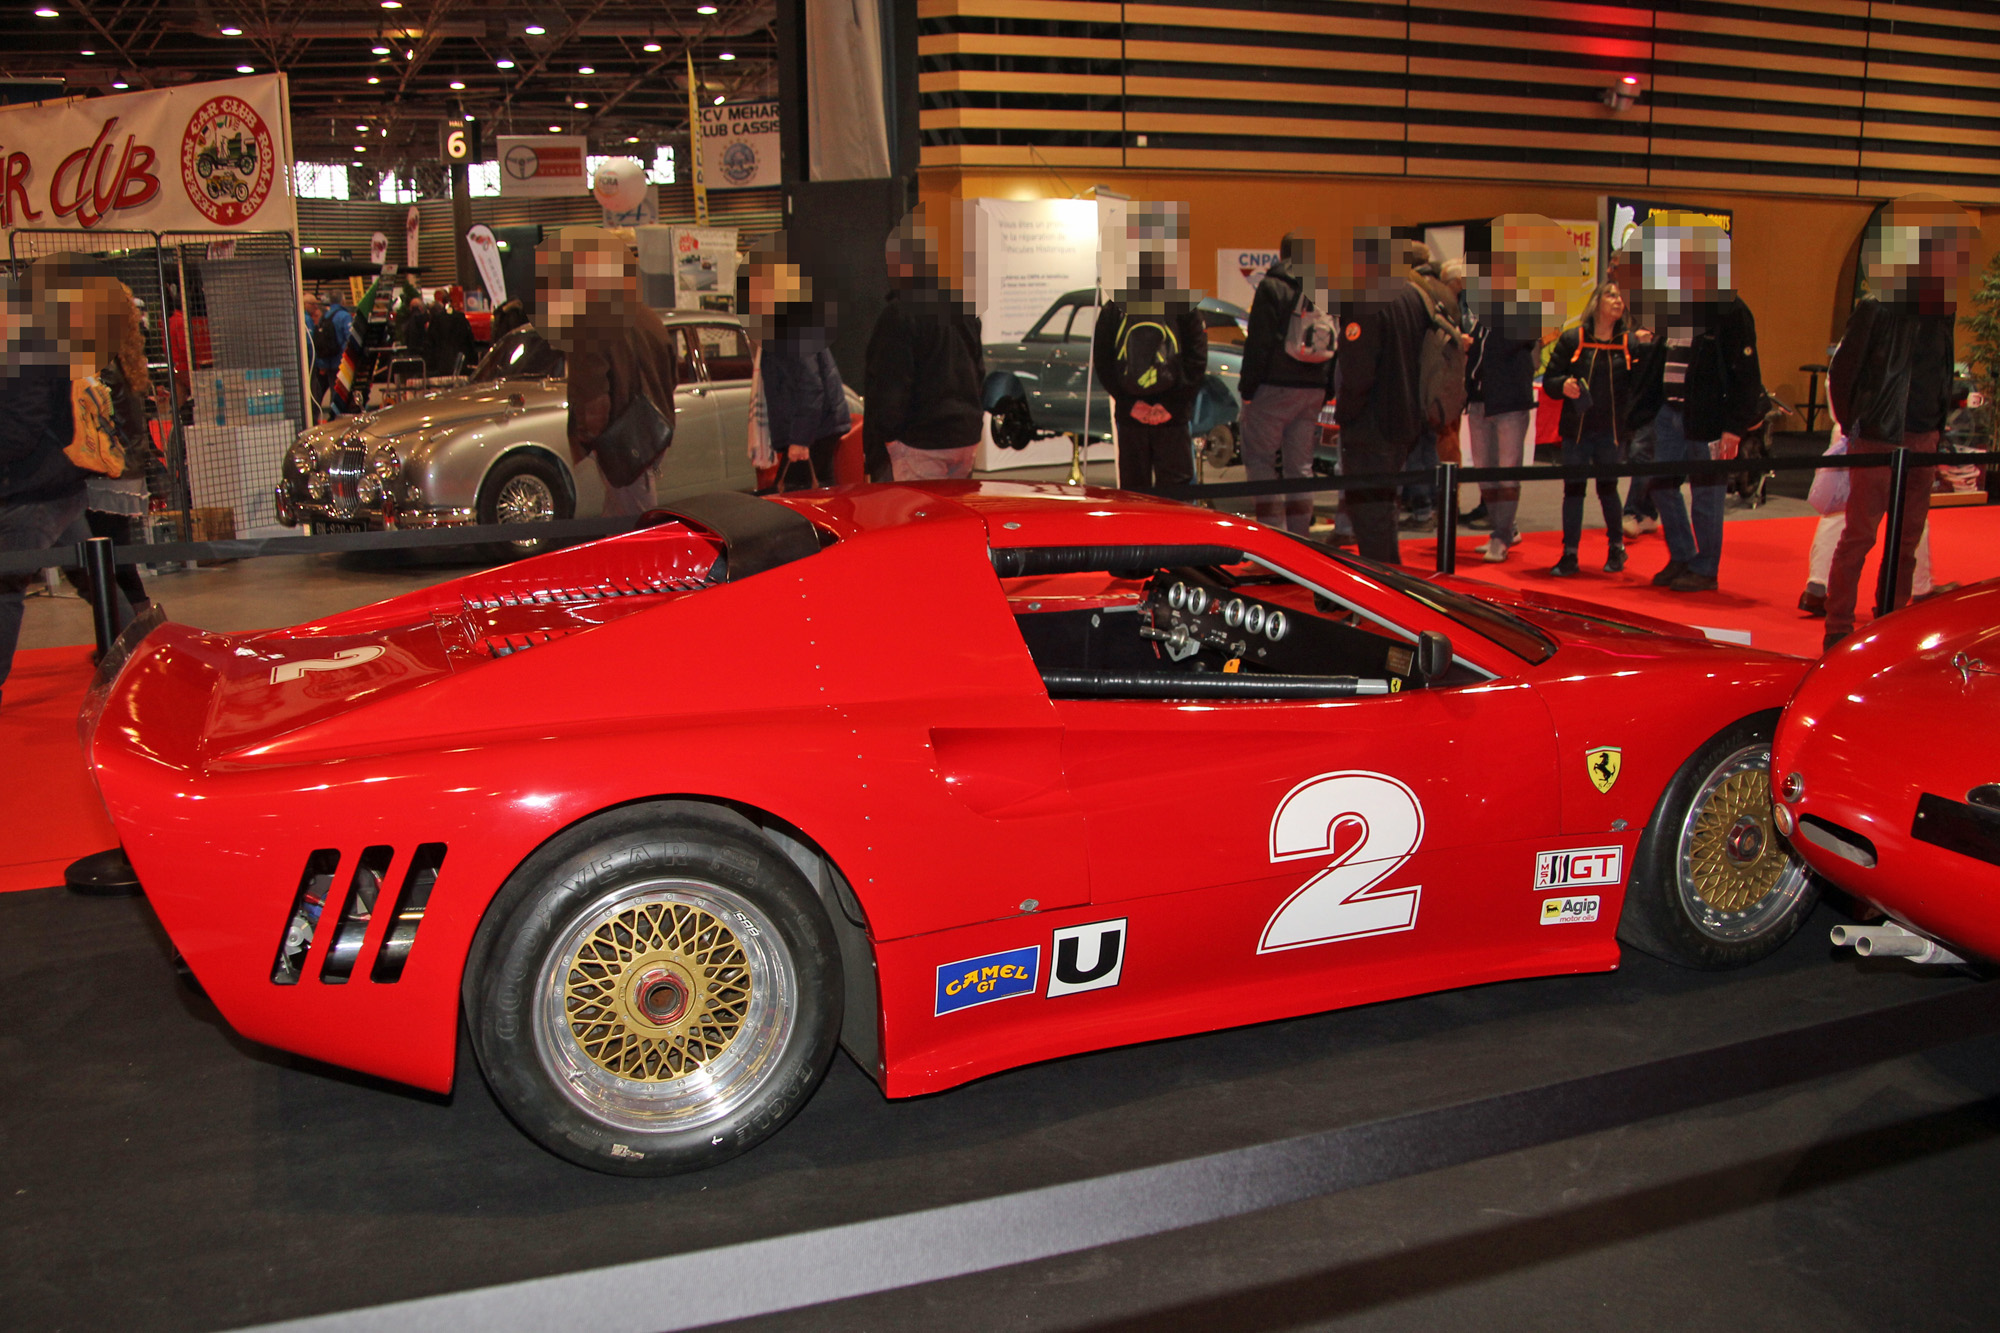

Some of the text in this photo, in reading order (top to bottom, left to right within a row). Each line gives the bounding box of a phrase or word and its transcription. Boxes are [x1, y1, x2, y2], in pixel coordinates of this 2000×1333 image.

[191, 102, 219, 135] CAR
[699, 123, 728, 138] LUB
[447, 130, 467, 159] 6
[0, 151, 43, 227] R
[1238, 253, 1280, 266] CNPA
[269, 645, 386, 686] 2
[1256, 769, 1425, 956] 2
[1540, 856, 1550, 886] IMSA
[1570, 853, 1616, 879] GT
[1560, 915, 1581, 923] motor
[1561, 898, 1598, 916] Agip
[1055, 929, 1122, 985] U
[945, 963, 1029, 996] CAMEL
[976, 978, 997, 995] GT
